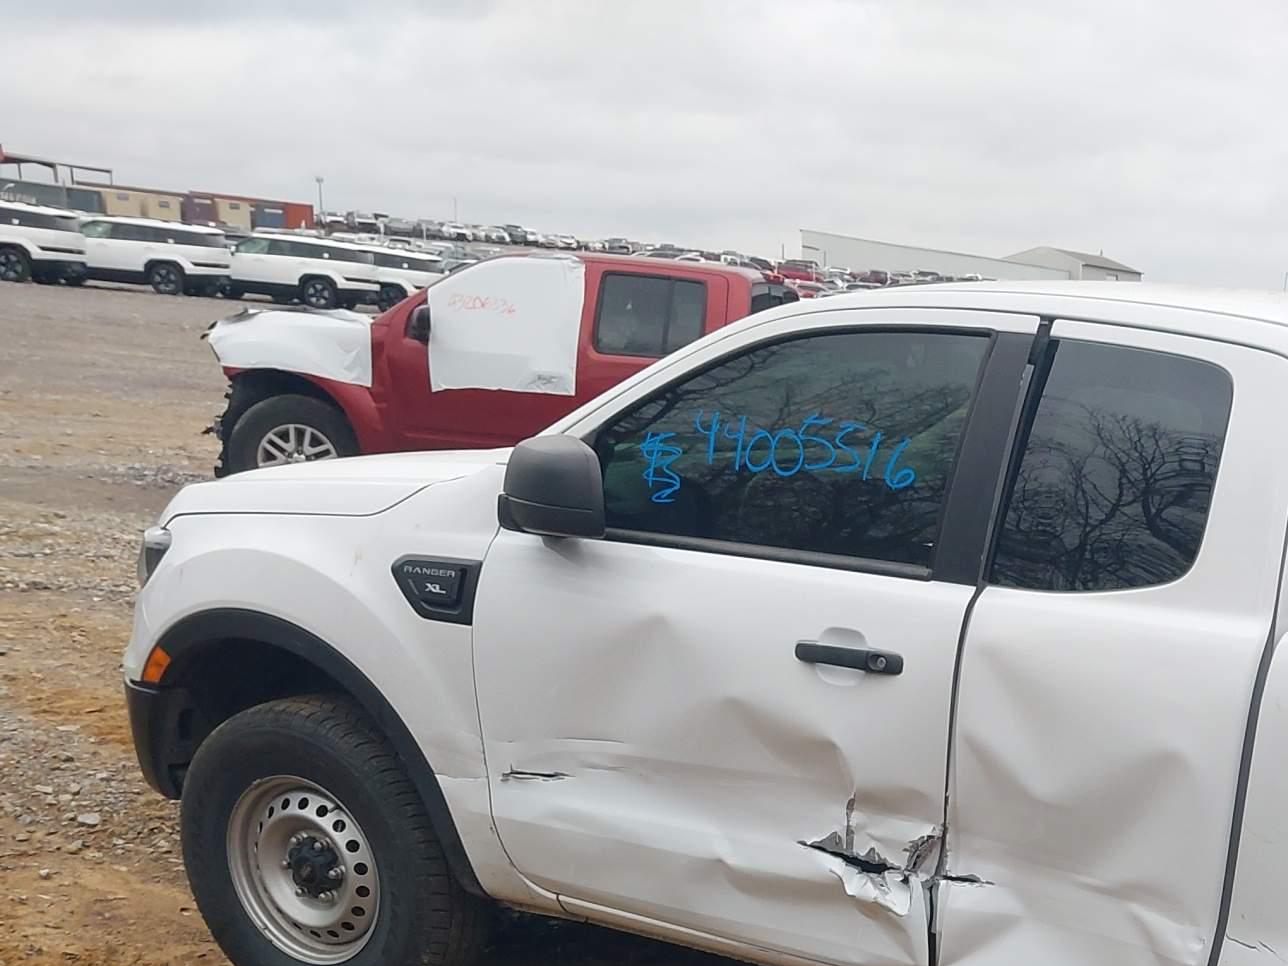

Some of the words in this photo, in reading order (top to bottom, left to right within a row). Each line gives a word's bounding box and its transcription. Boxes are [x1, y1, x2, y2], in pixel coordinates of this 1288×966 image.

[693, 409, 917, 491] 44005516
[403, 565, 456, 578] RANGER
[425, 582, 447, 594] XL
